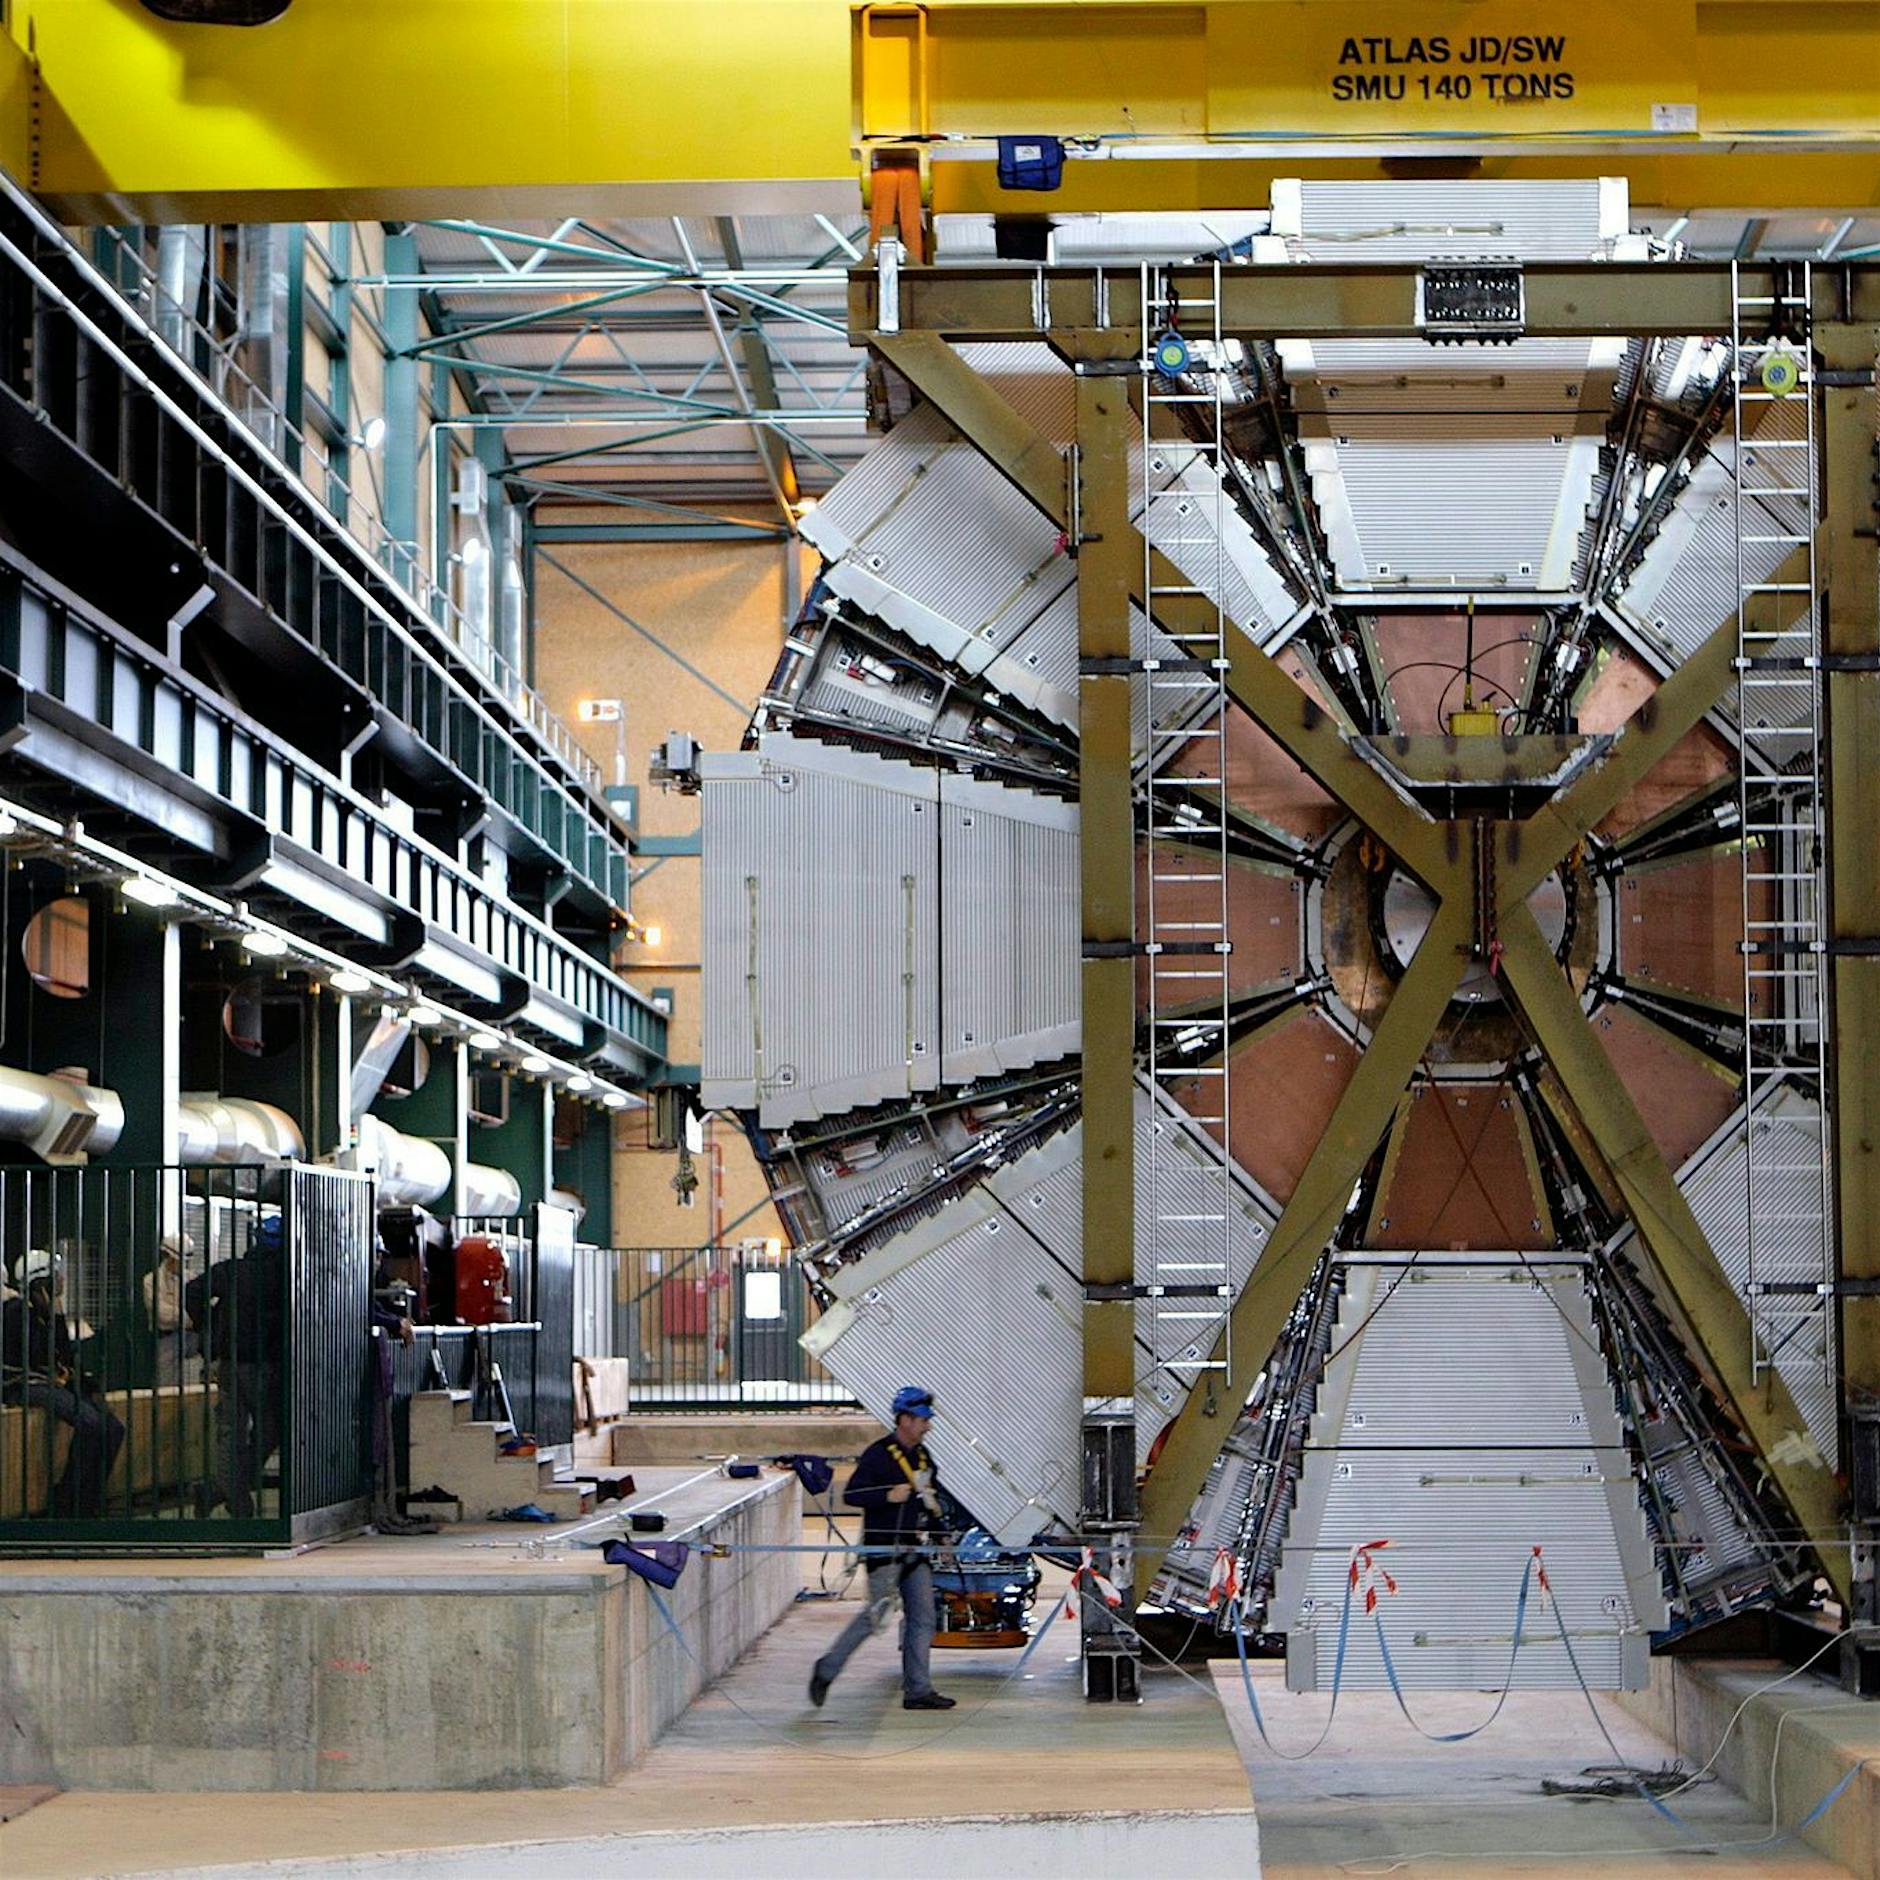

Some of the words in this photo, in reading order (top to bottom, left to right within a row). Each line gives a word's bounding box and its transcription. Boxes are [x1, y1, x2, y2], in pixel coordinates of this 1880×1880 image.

[1338, 36, 1451, 65] ATLAS
[1459, 36, 1566, 65] JD/SW
[1332, 74, 1406, 101] SMU
[1417, 74, 1472, 100] 140
[1480, 72, 1575, 100] TONS
